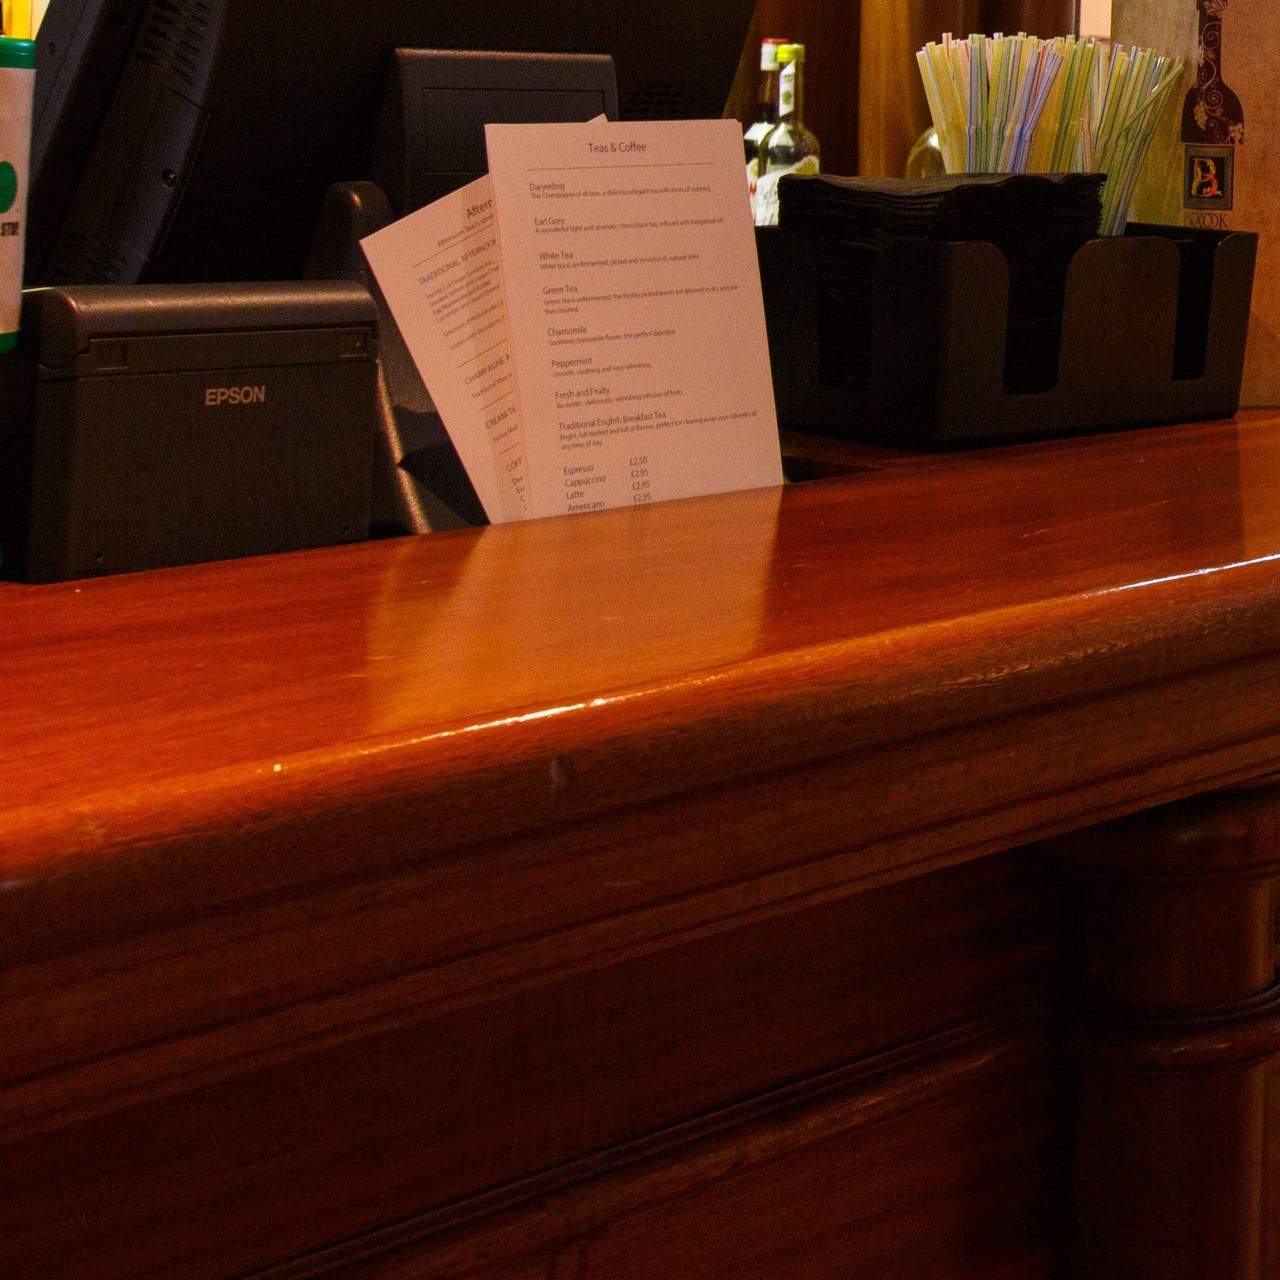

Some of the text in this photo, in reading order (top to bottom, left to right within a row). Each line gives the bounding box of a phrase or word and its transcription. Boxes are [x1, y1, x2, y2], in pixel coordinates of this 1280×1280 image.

[588, 141, 648, 153] Teas & Coffee
[529, 183, 565, 194] Darjeeling
[534, 216, 566, 227] Earl Grey
[539, 250, 574, 261] White Tea
[542, 284, 578, 295] Green Tea
[547, 325, 588, 337] Chamomile
[551, 357, 593, 369] Peppermint
[205, 385, 265, 406] EPSON
[555, 387, 610, 400] Fresh and Fruity
[559, 410, 667, 431] Traditional English Breakfast Tea
[563, 456, 648, 476] Espresso £2.50
[564, 467, 649, 488] Cappuccino £2.95
[566, 480, 650, 500] Latte £2.95
[567, 491, 652, 513] Americano £2.95
